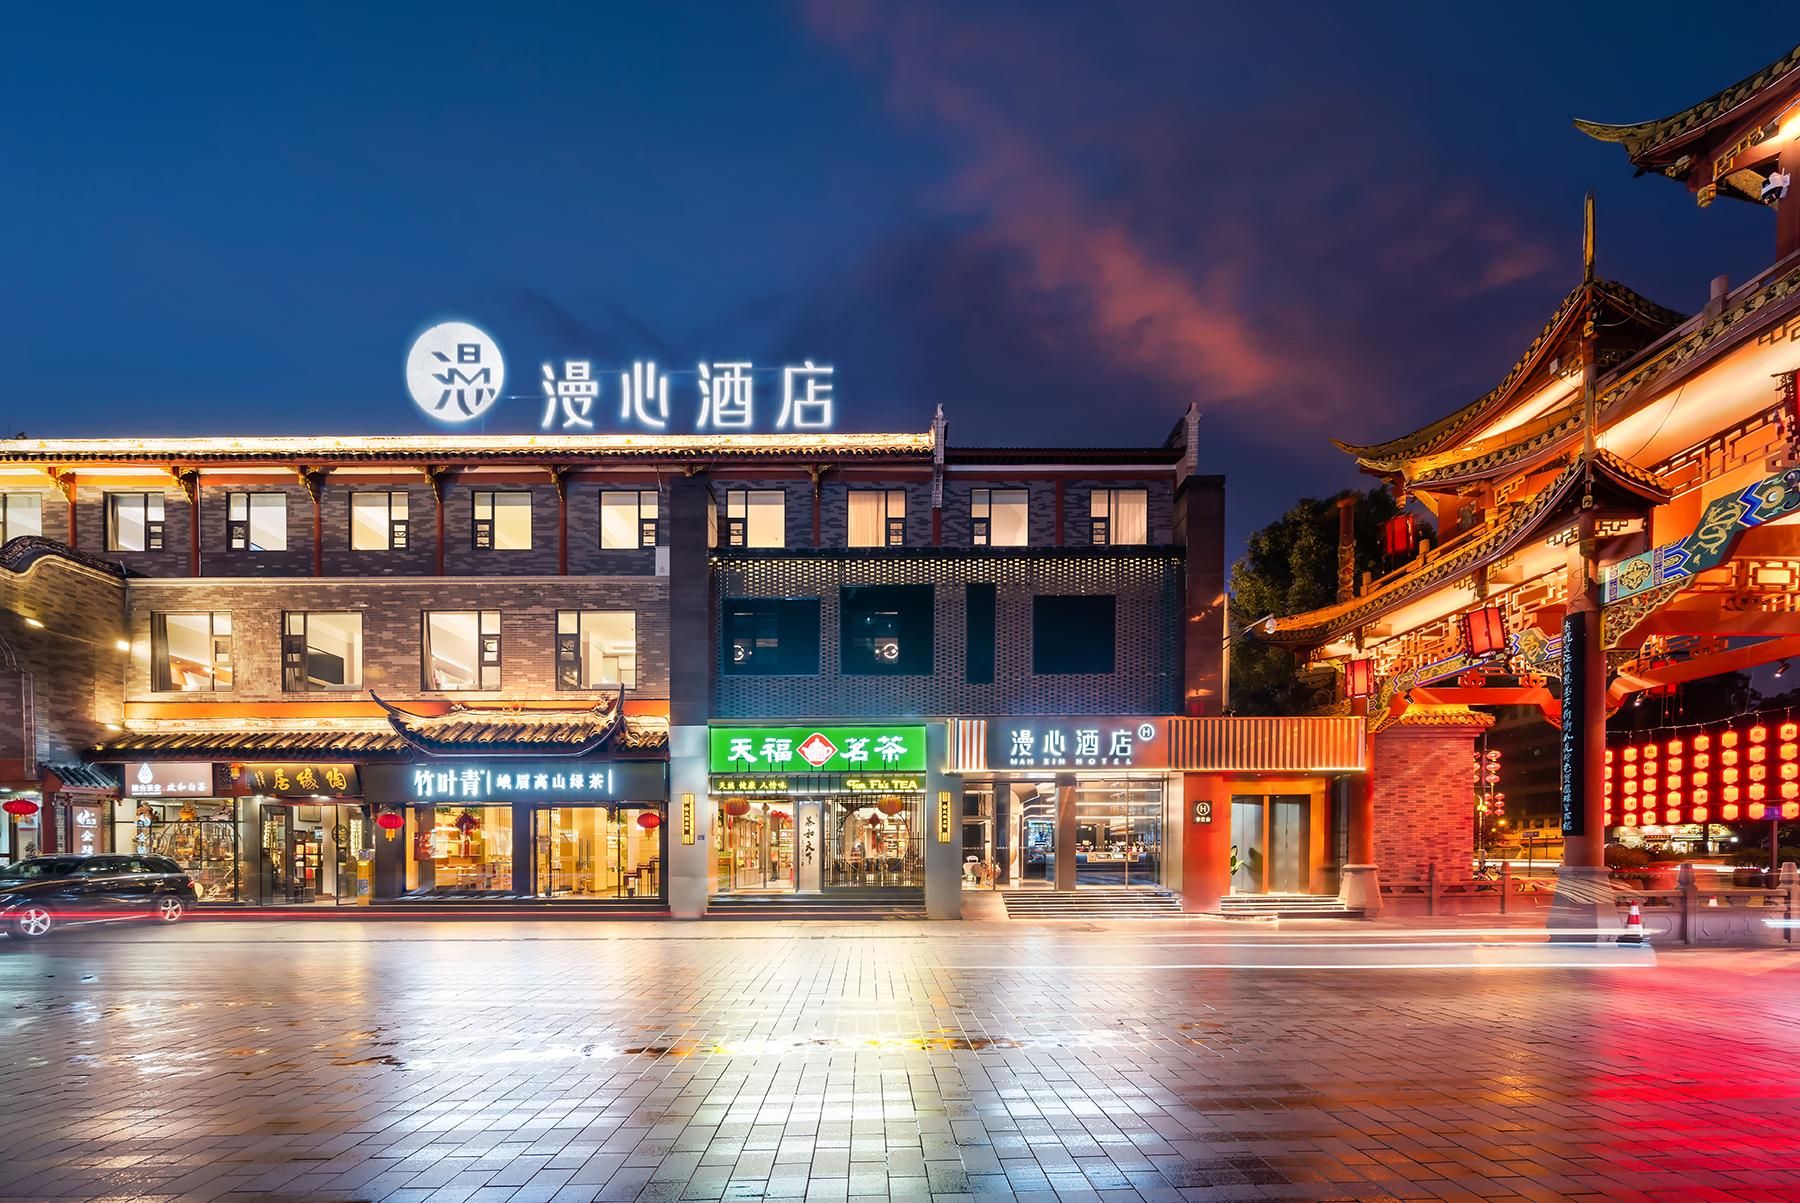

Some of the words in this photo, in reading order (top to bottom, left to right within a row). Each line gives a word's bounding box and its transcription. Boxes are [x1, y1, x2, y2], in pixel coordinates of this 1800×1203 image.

[542, 360, 834, 428] 漫心酒店
[727, 737, 793, 762] 天福
[840, 735, 908, 762] 茗茶
[1010, 729, 1132, 756] 漫心酒店
[414, 769, 481, 796] 竹叶青
[496, 773, 604, 790] 峨眉高山绿茶
[891, 780, 917, 789] TEA
